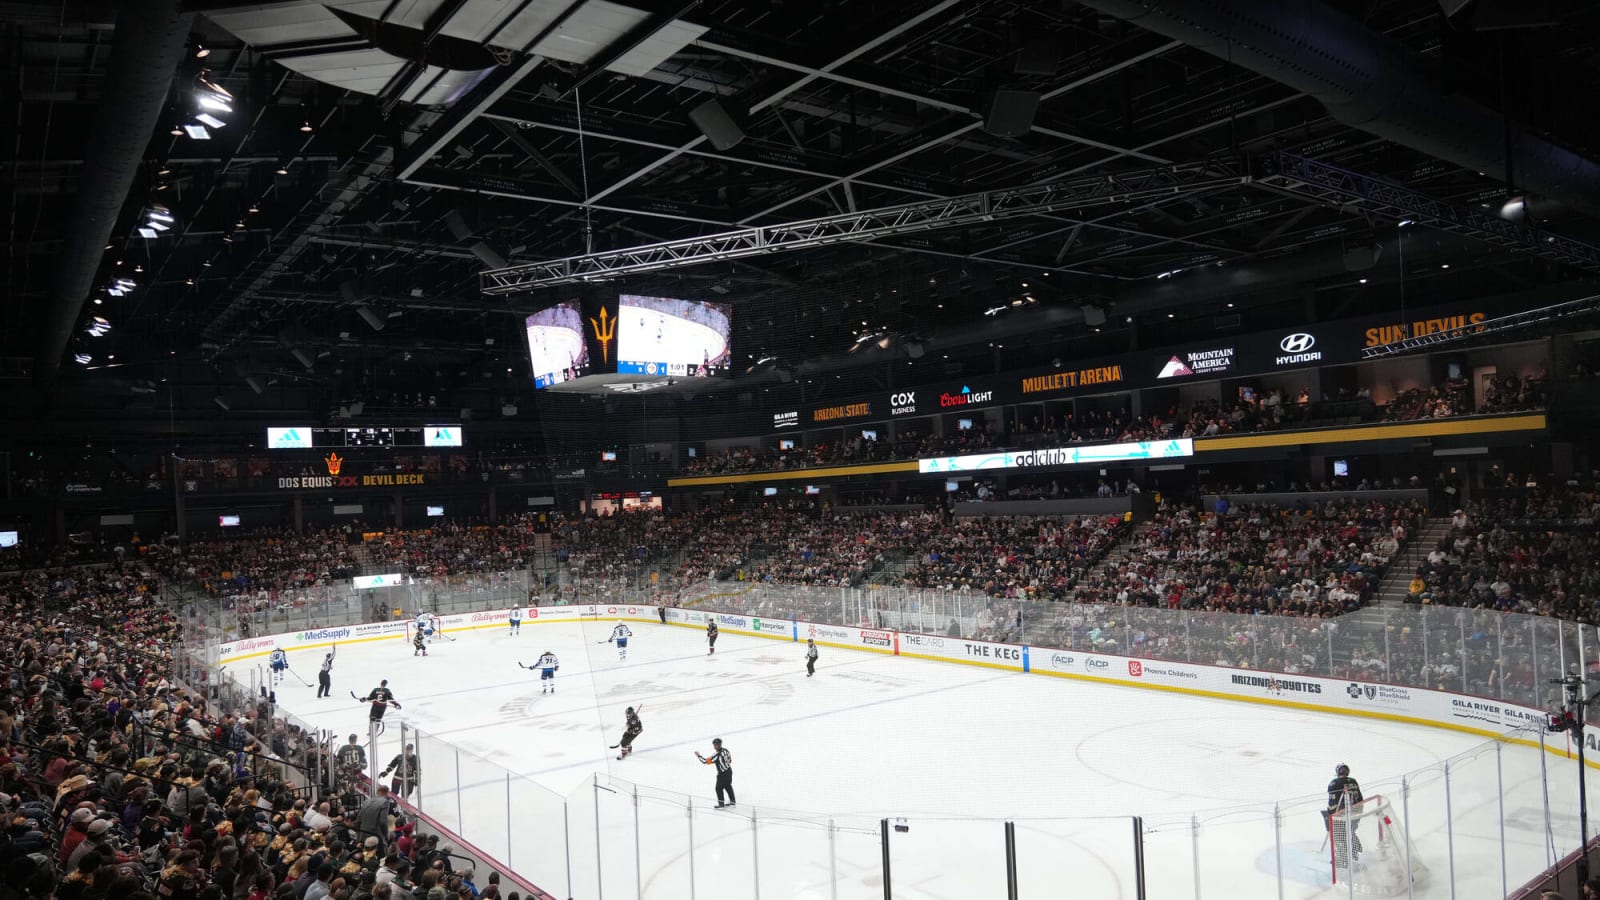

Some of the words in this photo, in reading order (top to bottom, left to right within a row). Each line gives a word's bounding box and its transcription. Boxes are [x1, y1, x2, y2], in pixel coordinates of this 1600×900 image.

[1365, 324, 1406, 347] SUN
[1187, 348, 1233, 362] MOUNTAIN
[1276, 352, 1322, 365] HYUNDAI
[1191, 357, 1231, 370] AMERICA
[1022, 371, 1076, 393] MULLETT
[1079, 365, 1121, 386] ARENA
[890, 391, 915, 406] COX
[940, 392, 966, 407] Coors
[967, 391, 993, 404] LIGHT
[814, 407, 845, 421] ARIZONA
[846, 403, 869, 417] STATE
[891, 405, 916, 415] BUSINESS
[1015, 449, 1066, 468] adiclub
[278, 477, 299, 488] DOS
[302, 476, 332, 488] EQUIS
[363, 475, 394, 486] DEVIL
[397, 474, 425, 485] DECK
[720, 615, 746, 627] MedSupply
[304, 628, 350, 641] MedSupply
[905, 635, 921, 645] THE
[964, 644, 989, 657] THE
[994, 648, 1020, 660] KEG
[1054, 656, 1074, 665] ACP
[1089, 659, 1109, 668] ACP
[1144, 667, 1166, 675] Phoenix
[1231, 674, 1270, 687] ARIZONA
[1276, 680, 1321, 694] COYOTES
[1452, 699, 1472, 708] GILA
[1474, 703, 1500, 713] RIVER
[1504, 709, 1524, 718] GILA
